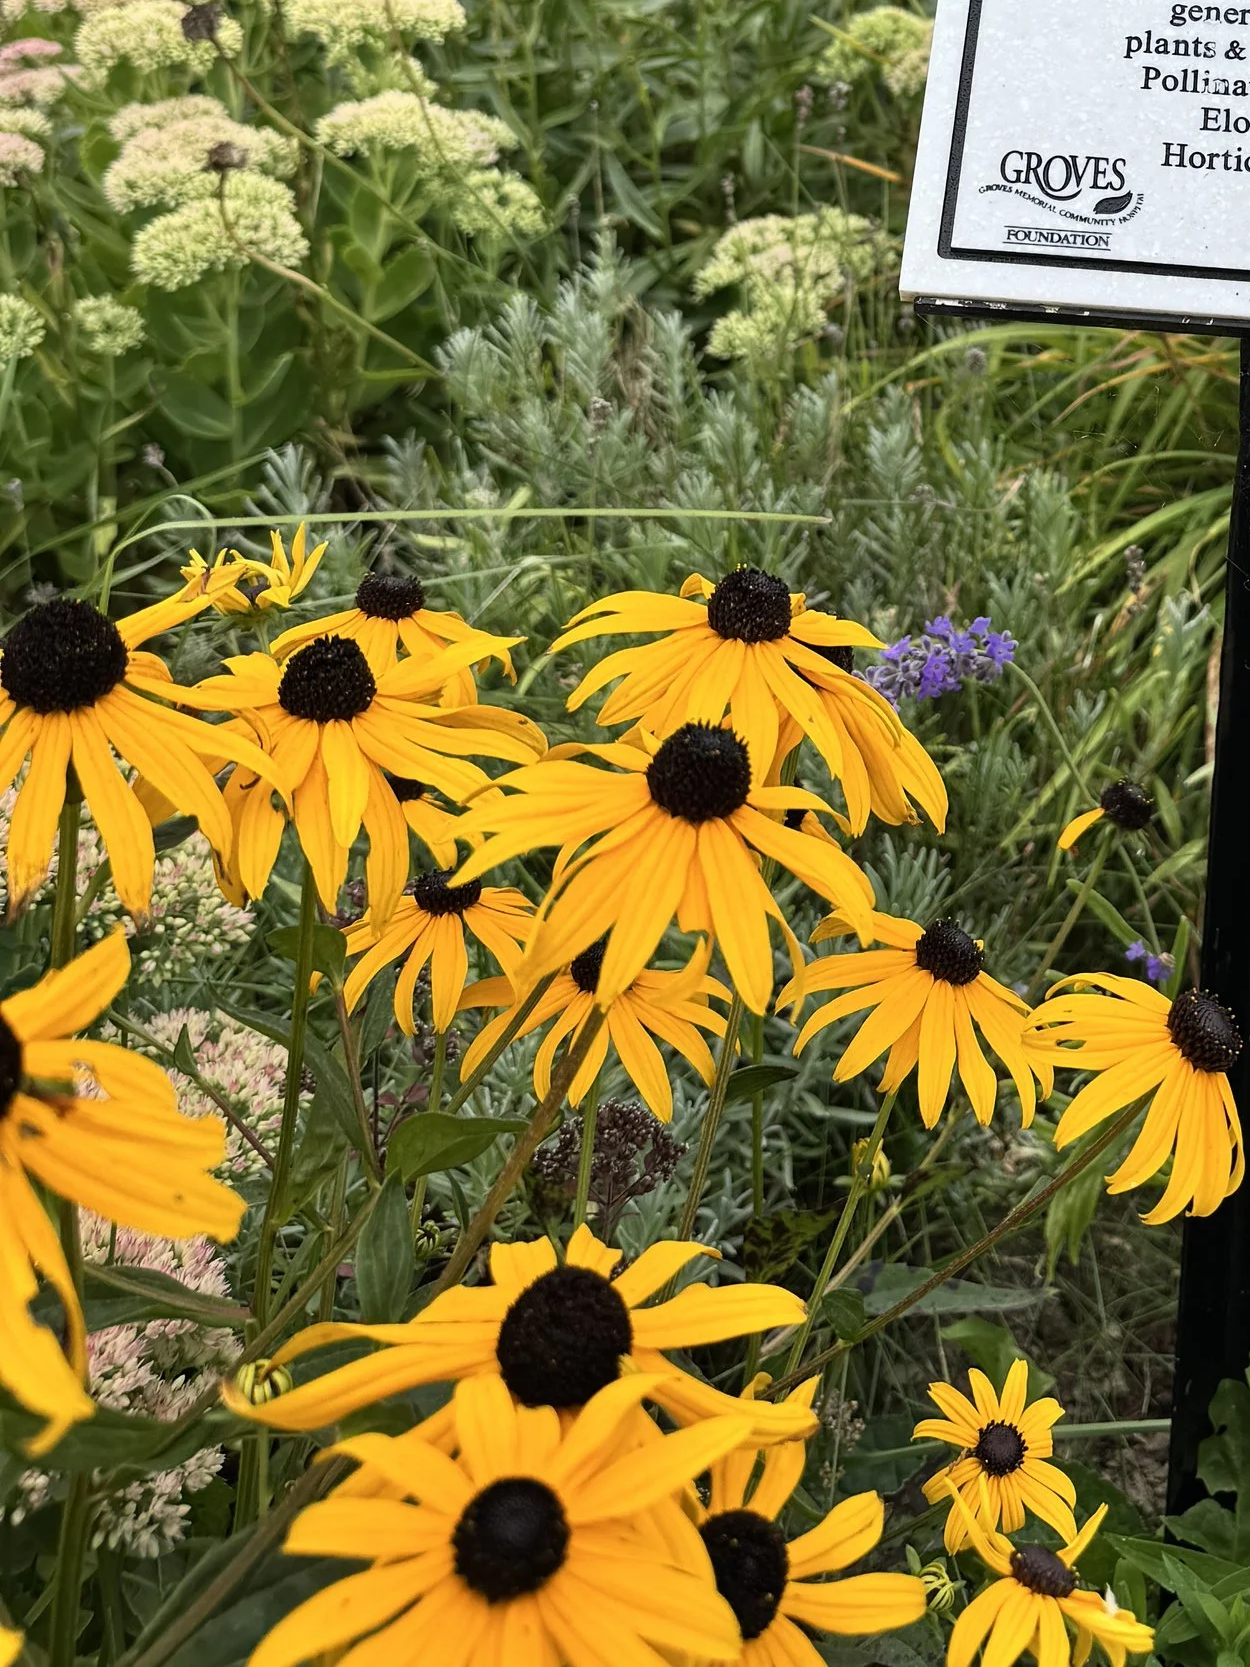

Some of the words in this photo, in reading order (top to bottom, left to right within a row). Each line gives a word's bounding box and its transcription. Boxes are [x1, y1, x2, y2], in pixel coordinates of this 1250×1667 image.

[1123, 30, 1217, 59] plants
[1224, 40, 1248, 61] &
[1000, 149, 1127, 202] GROVES
[978, 183, 1013, 194] GROVES
[1014, 188, 1057, 214] MEMORIAL
[1058, 209, 1117, 226] COMMUNITY
[1006, 229, 1110, 248] FOUNDATION
